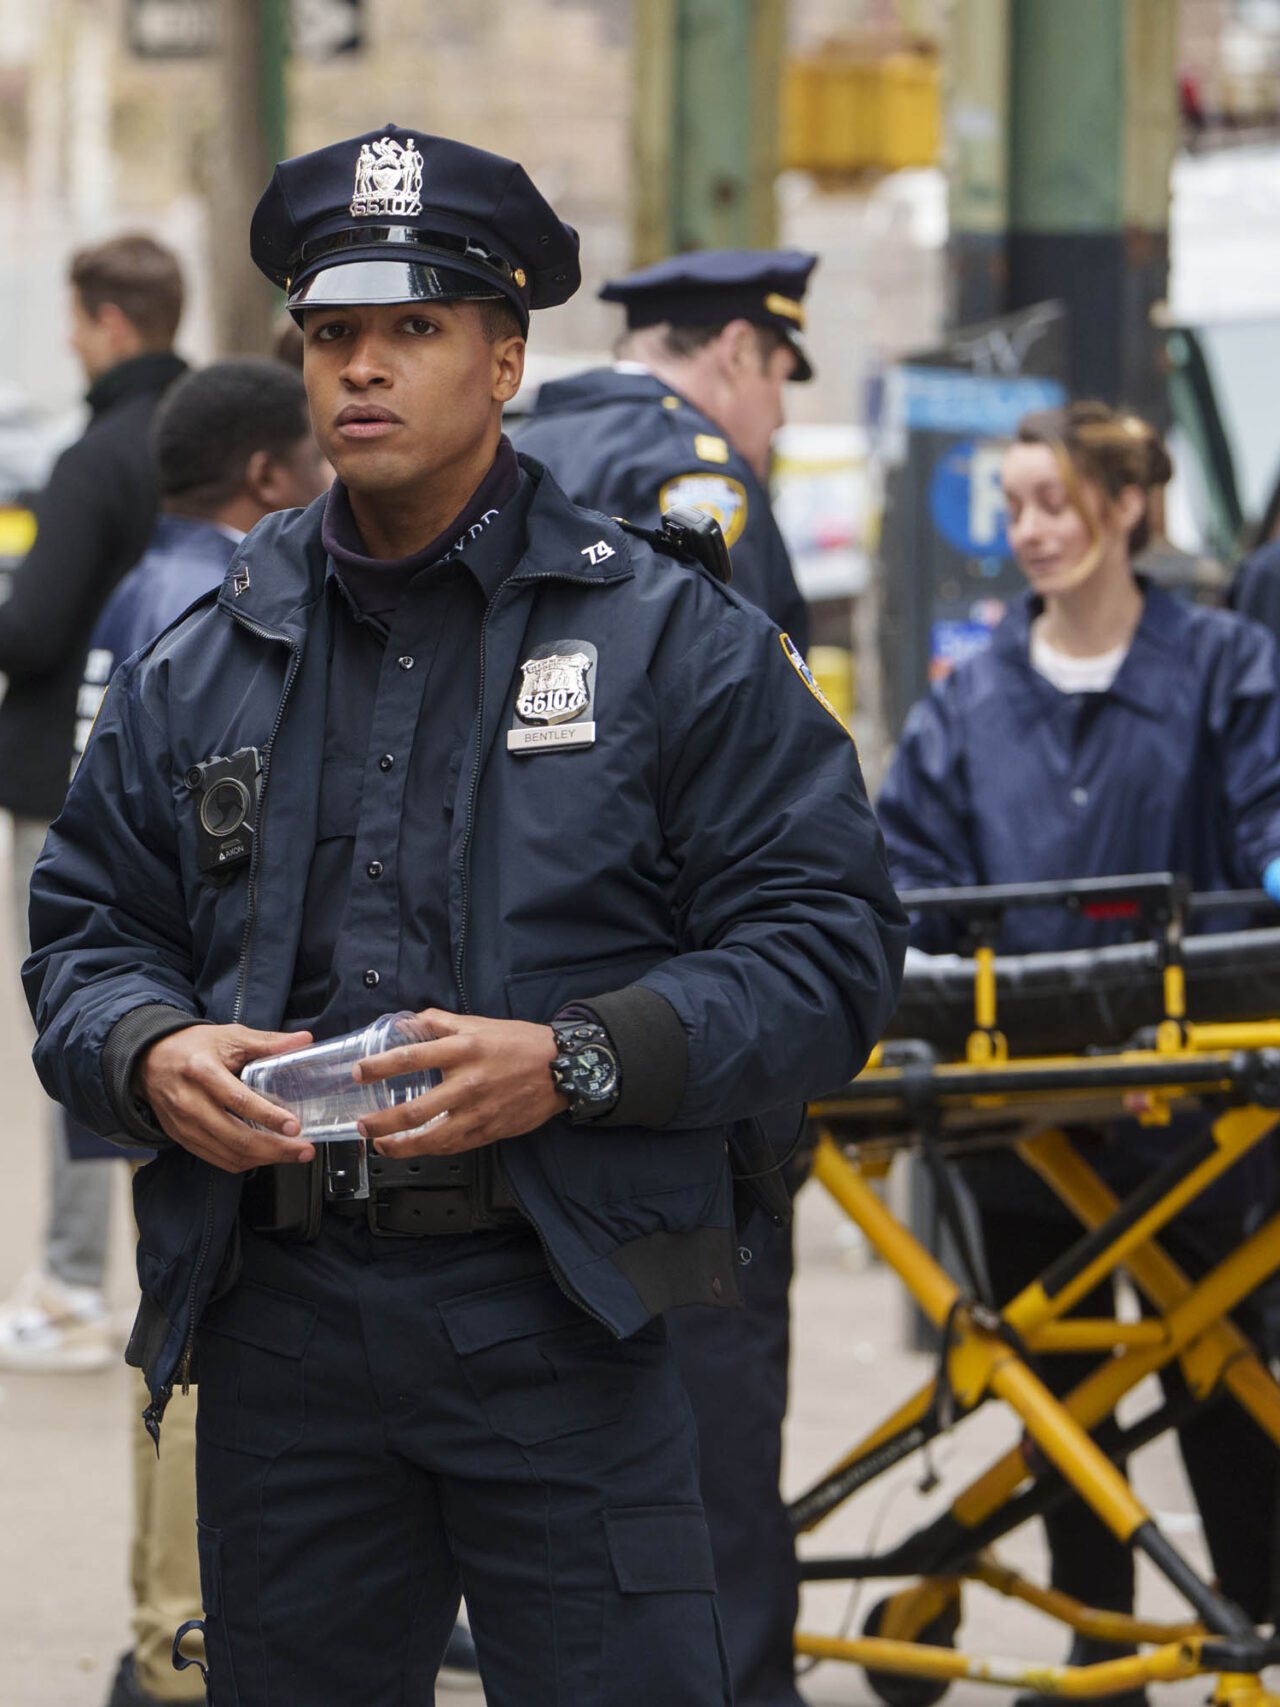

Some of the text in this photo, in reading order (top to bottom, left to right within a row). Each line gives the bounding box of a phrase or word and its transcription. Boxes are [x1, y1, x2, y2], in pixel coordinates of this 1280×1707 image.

[354, 198, 419, 216] 66107
[581, 540, 616, 565] 74
[520, 689, 583, 715] 66107
[524, 729, 576, 743] BENTLEY
